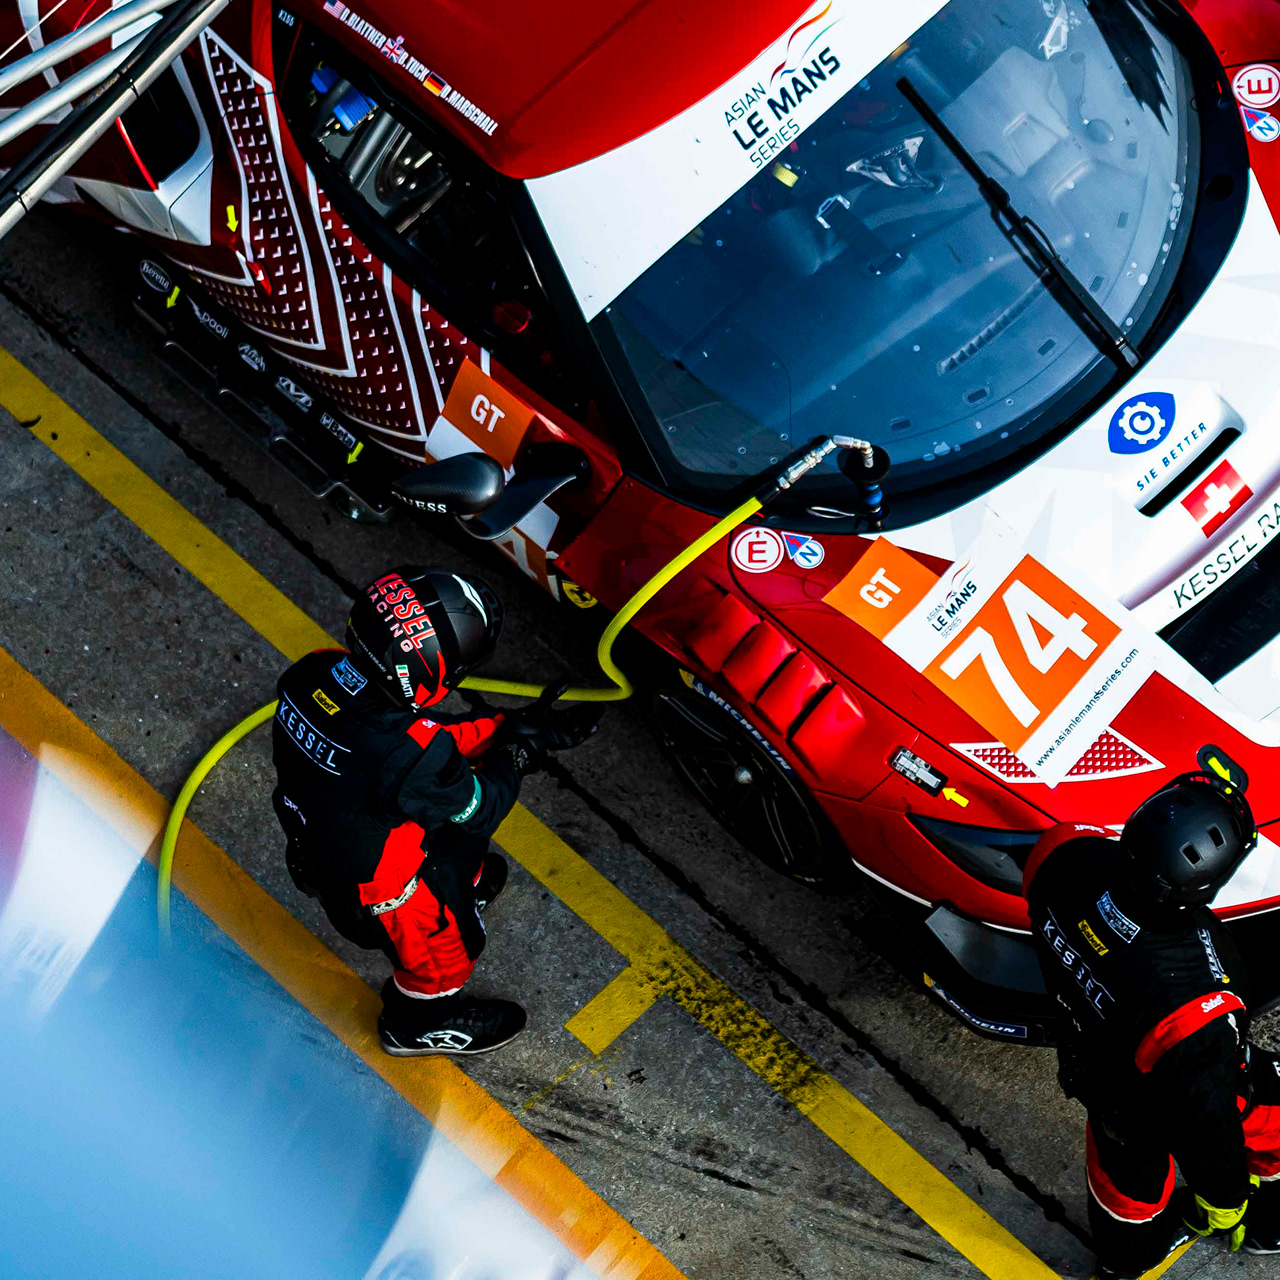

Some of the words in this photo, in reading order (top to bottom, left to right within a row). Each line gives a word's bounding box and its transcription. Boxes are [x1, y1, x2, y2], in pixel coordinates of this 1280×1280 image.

[339, 7, 387, 49] D.BLATTNER
[439, 84, 499, 136] D.MARSCHALL
[724, 81, 767, 127] ASIAN
[732, 110, 770, 151] LE
[766, 46, 841, 121] MANS
[749, 118, 800, 169] SERIES
[142, 262, 170, 289] Beretta
[202, 311, 229, 339] paoli
[329, 421, 357, 448] Beta
[470, 394, 505, 432] GT
[1136, 468, 1158, 491] SIE
[1161, 422, 1207, 468] BETTER
[747, 540, 768, 564] E
[799, 545, 819, 564] N
[1173, 535, 1258, 608] KESSEL
[859, 567, 902, 609] GT
[931, 615, 948, 632] LE
[945, 580, 978, 617] MANS
[926, 603, 945, 623] ASIAN
[940, 617, 962, 639] SERIES
[939, 578, 1099, 729] 74
[708, 690, 792, 770] MICHELIN
[1035, 647, 1140, 768] www.asianlemansseries.com
[279, 701, 336, 768] KESSEL
[1080, 922, 1108, 955] Sabelt
[1044, 919, 1103, 1009] KESSEL
